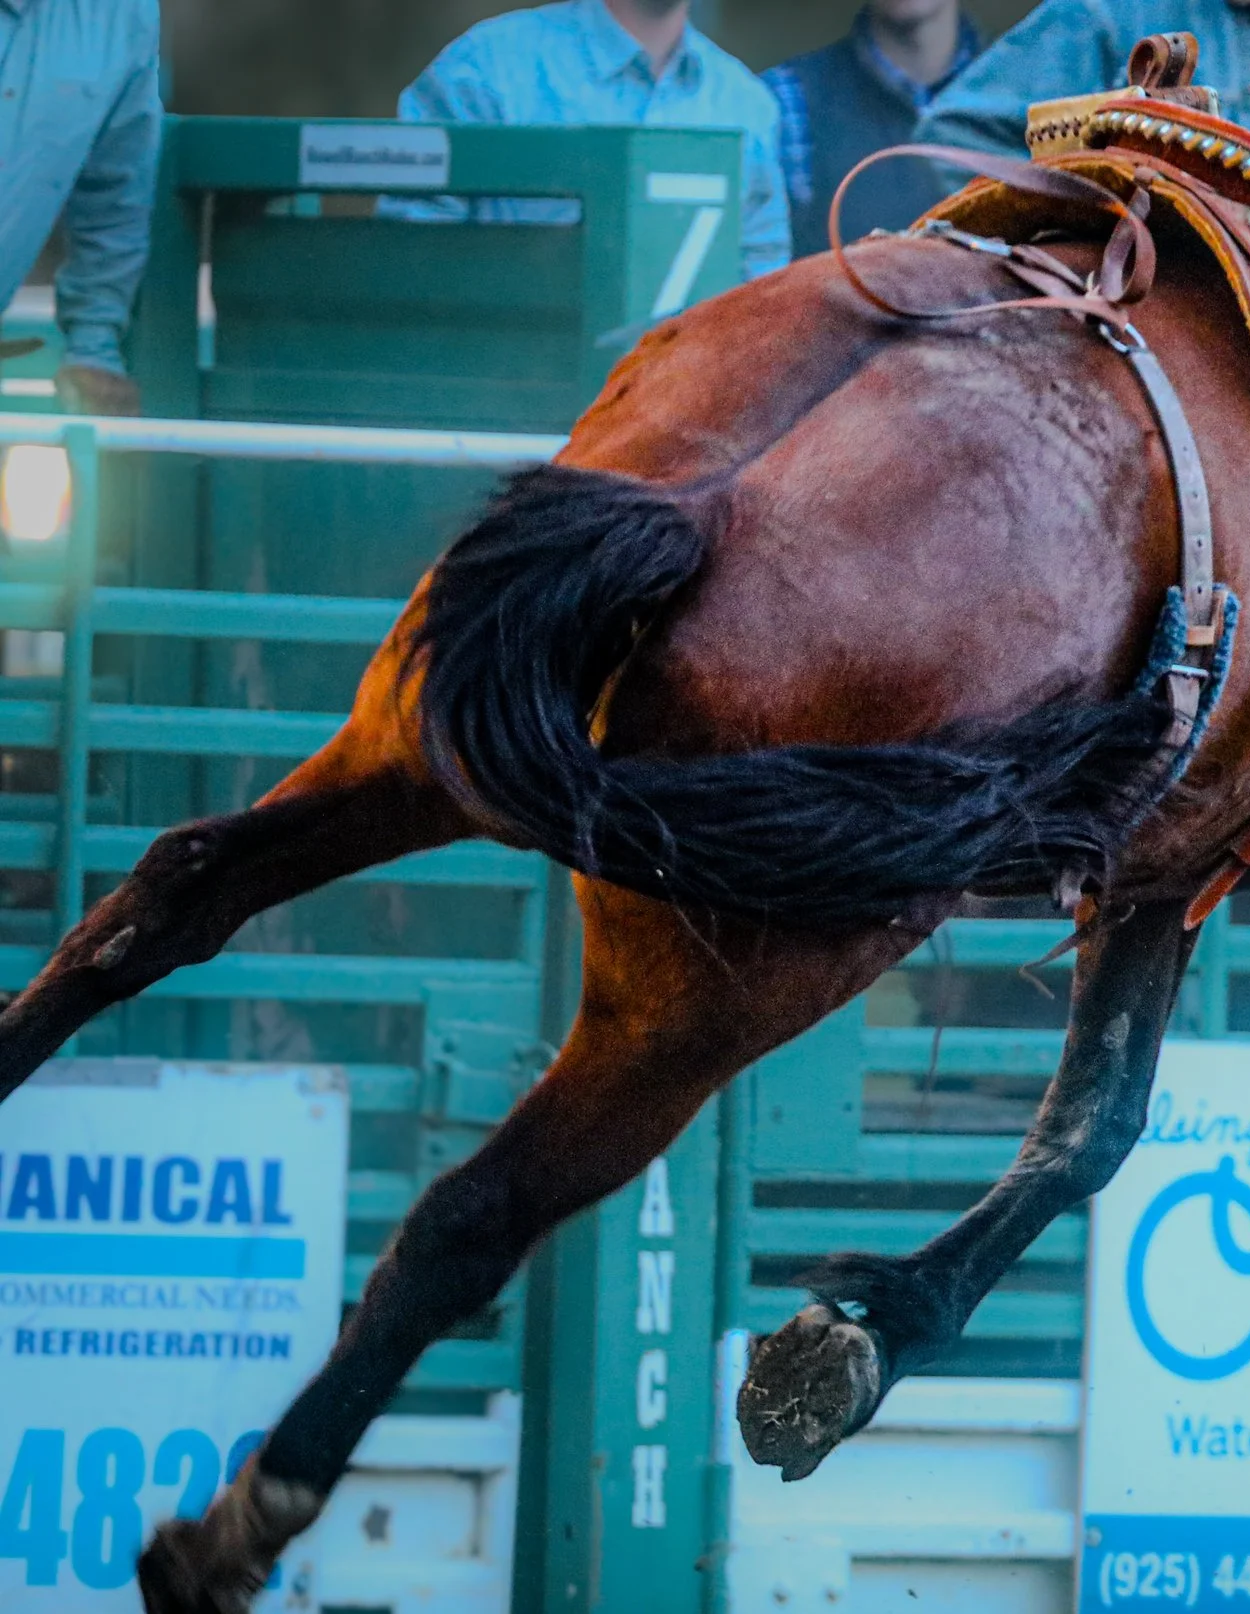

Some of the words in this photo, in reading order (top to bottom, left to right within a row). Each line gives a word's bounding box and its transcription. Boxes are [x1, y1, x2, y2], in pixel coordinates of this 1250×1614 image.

[647, 172, 728, 319] 7
[0, 1153, 293, 1226] ANICAL
[195, 1284, 302, 1312] NEEDS
[14, 1328, 293, 1360] REFRIGERATION
[0, 1427, 282, 1590] 482
[1100, 1552, 1200, 1606] (925)
